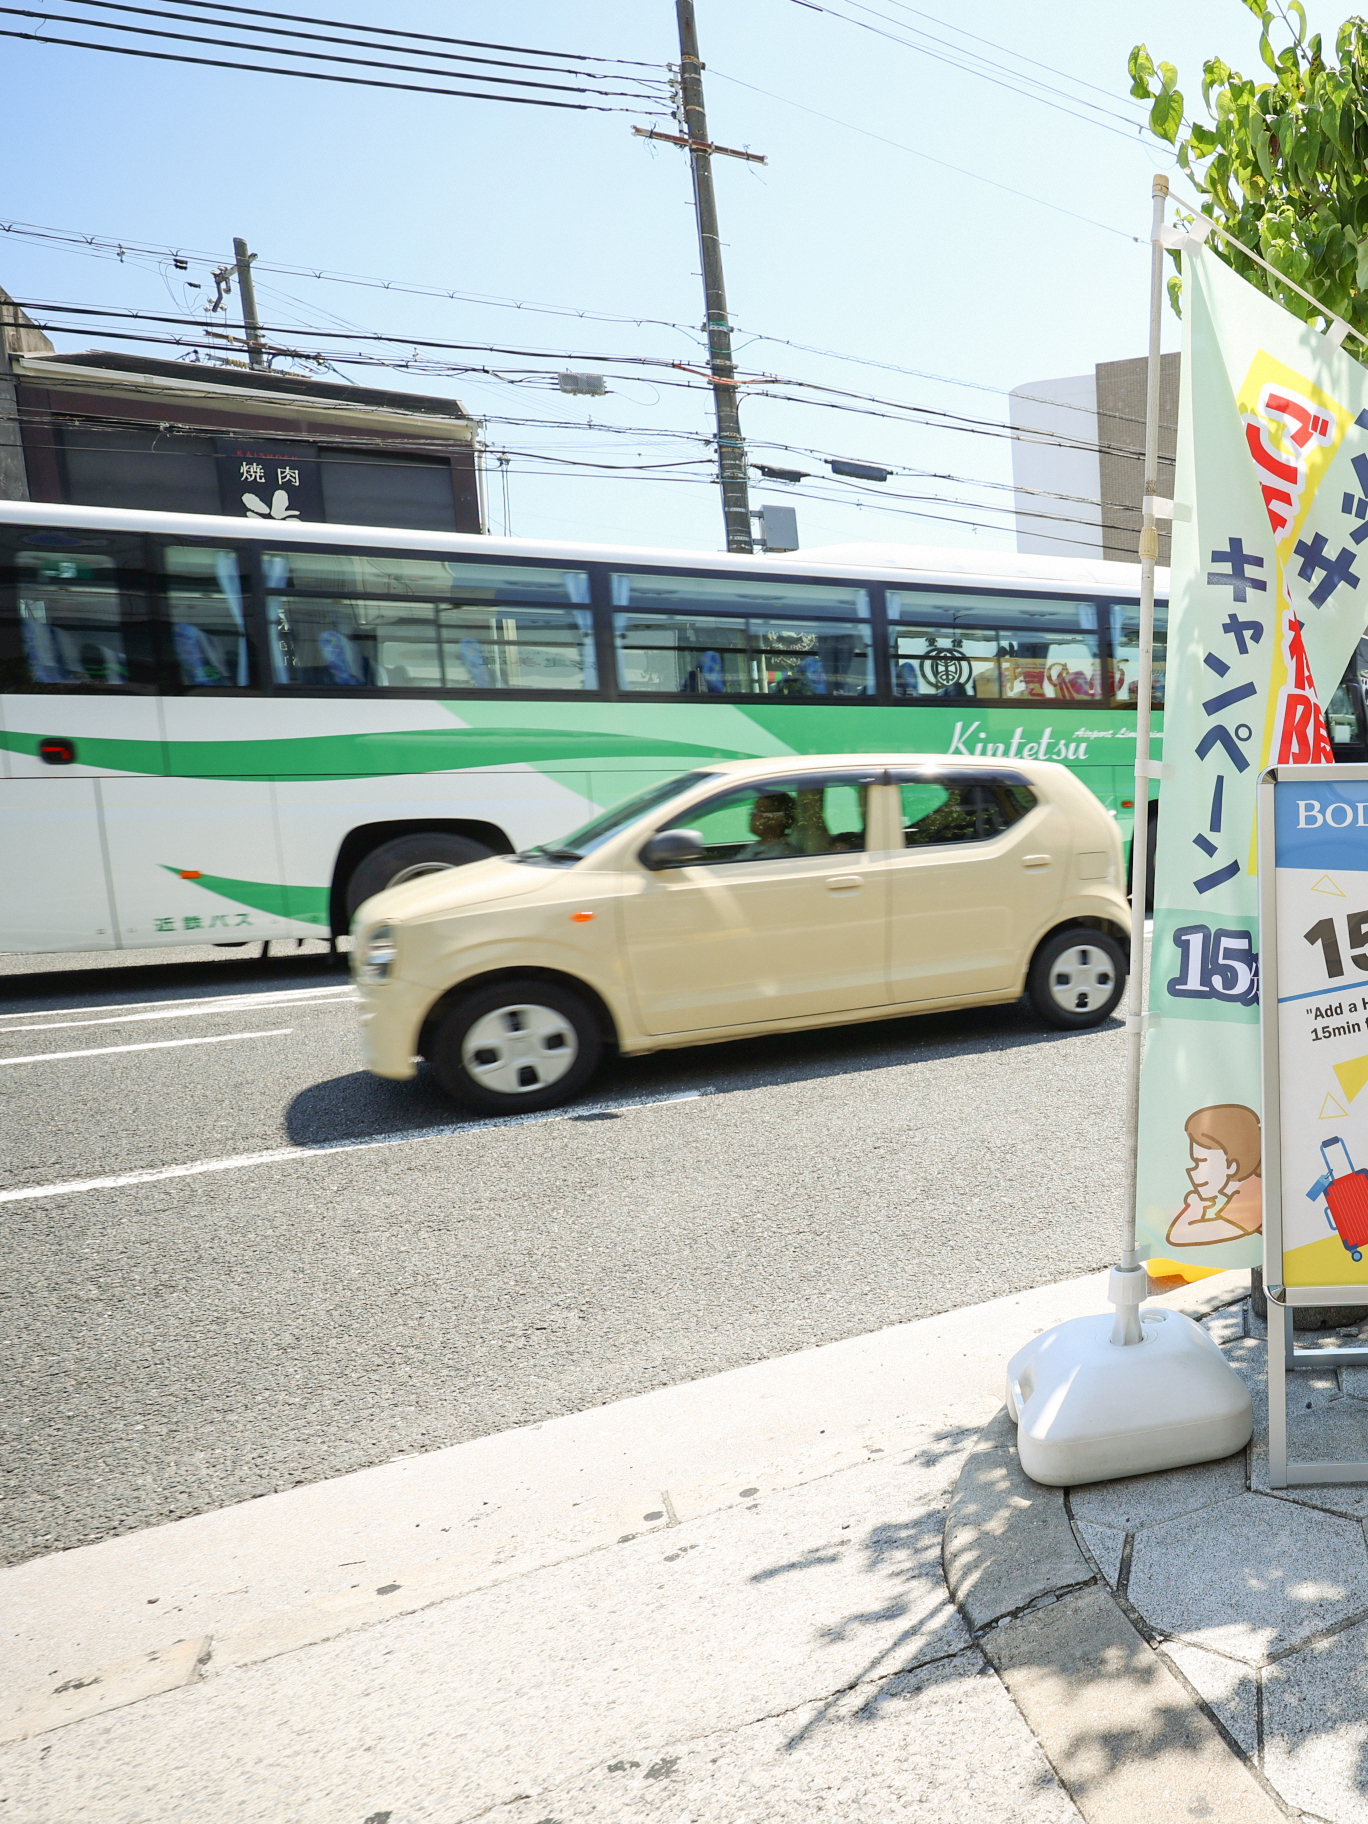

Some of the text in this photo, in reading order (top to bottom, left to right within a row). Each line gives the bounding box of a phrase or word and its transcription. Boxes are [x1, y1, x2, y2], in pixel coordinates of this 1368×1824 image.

[240, 462, 300, 486] 焼肉
[1193, 536, 1268, 896] キャンペーン
[947, 721, 1089, 760] Kintetsu
[154, 913, 253, 932] 近鉄バス
[1306, 1000, 1344, 1021] "Add
[1348, 1002, 1358, 1015] a
[1310, 1018, 1362, 1042] 15min
